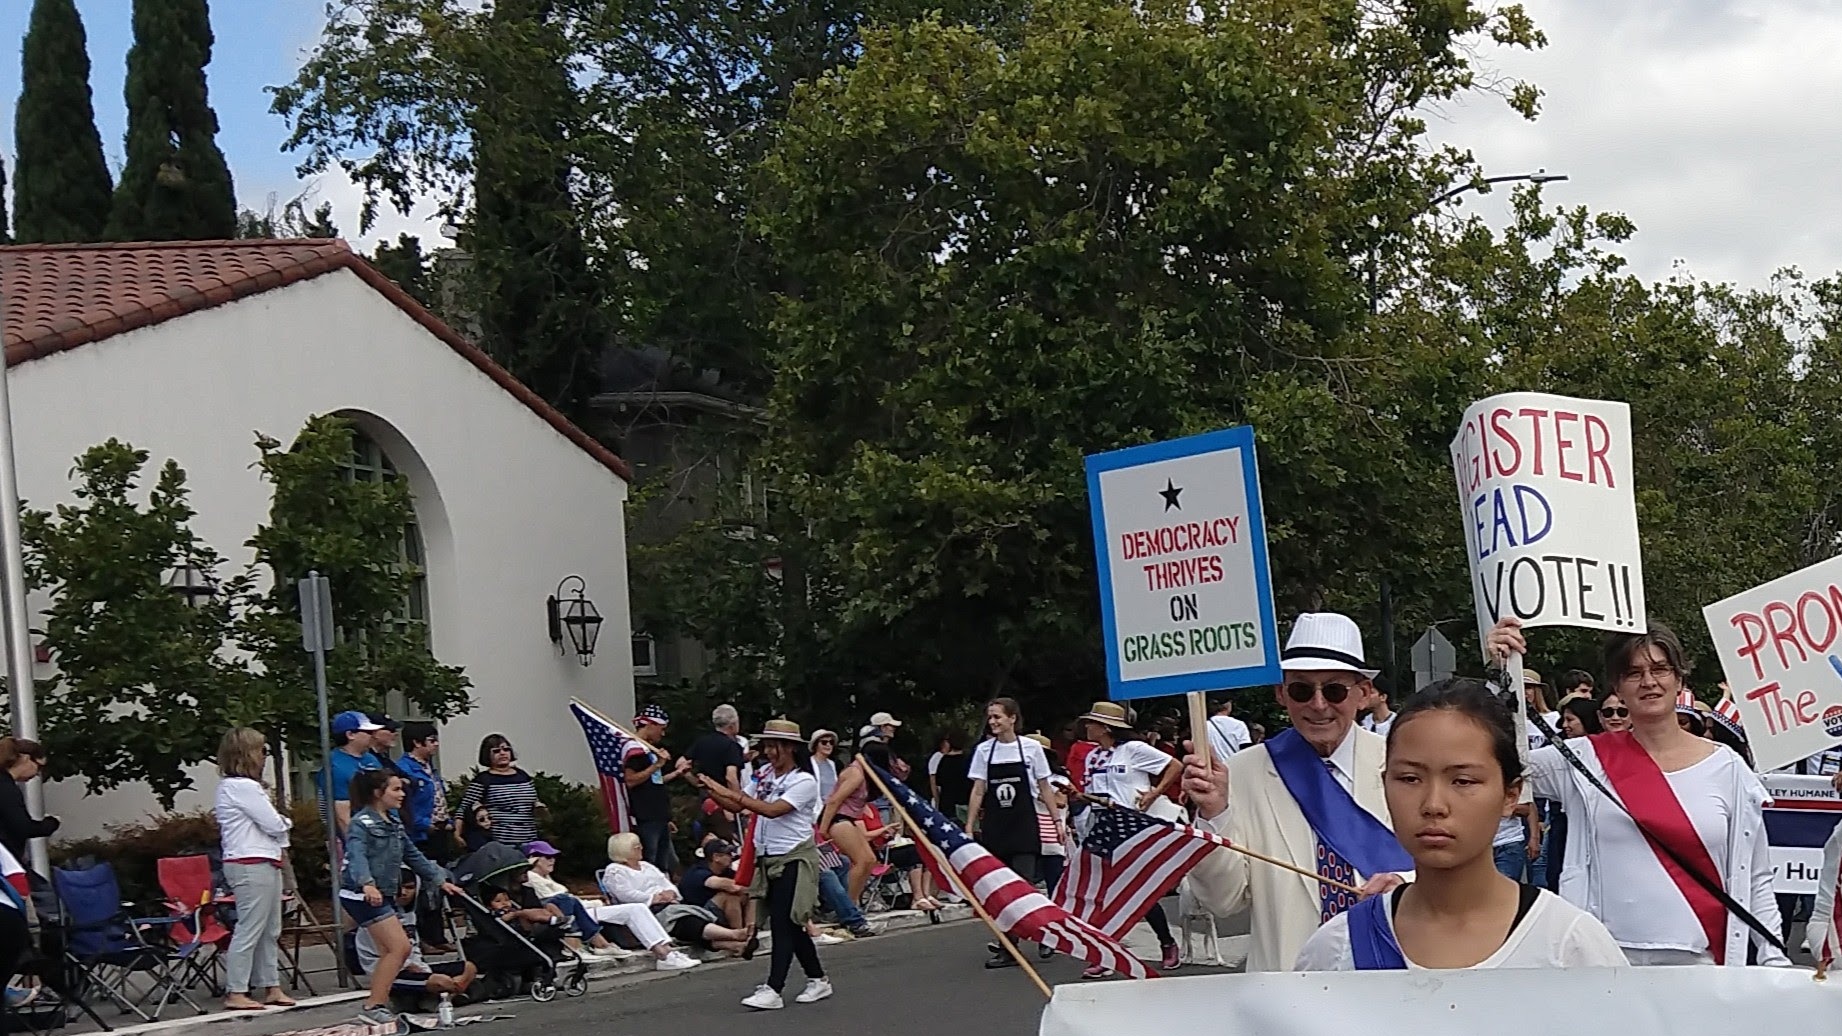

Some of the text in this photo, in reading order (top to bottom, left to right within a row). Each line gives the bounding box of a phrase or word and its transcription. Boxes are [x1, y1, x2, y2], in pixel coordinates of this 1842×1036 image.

[1121, 516, 1240, 560] DEMOCRACY
[1143, 555, 1224, 592] THRIVES
[1480, 556, 1635, 628] VOTE!!
[1170, 593, 1198, 622] ON
[1123, 621, 1257, 663] GRASS ROOTS
[1745, 682, 1819, 736] The
[1790, 789, 1835, 798] HUMANE
